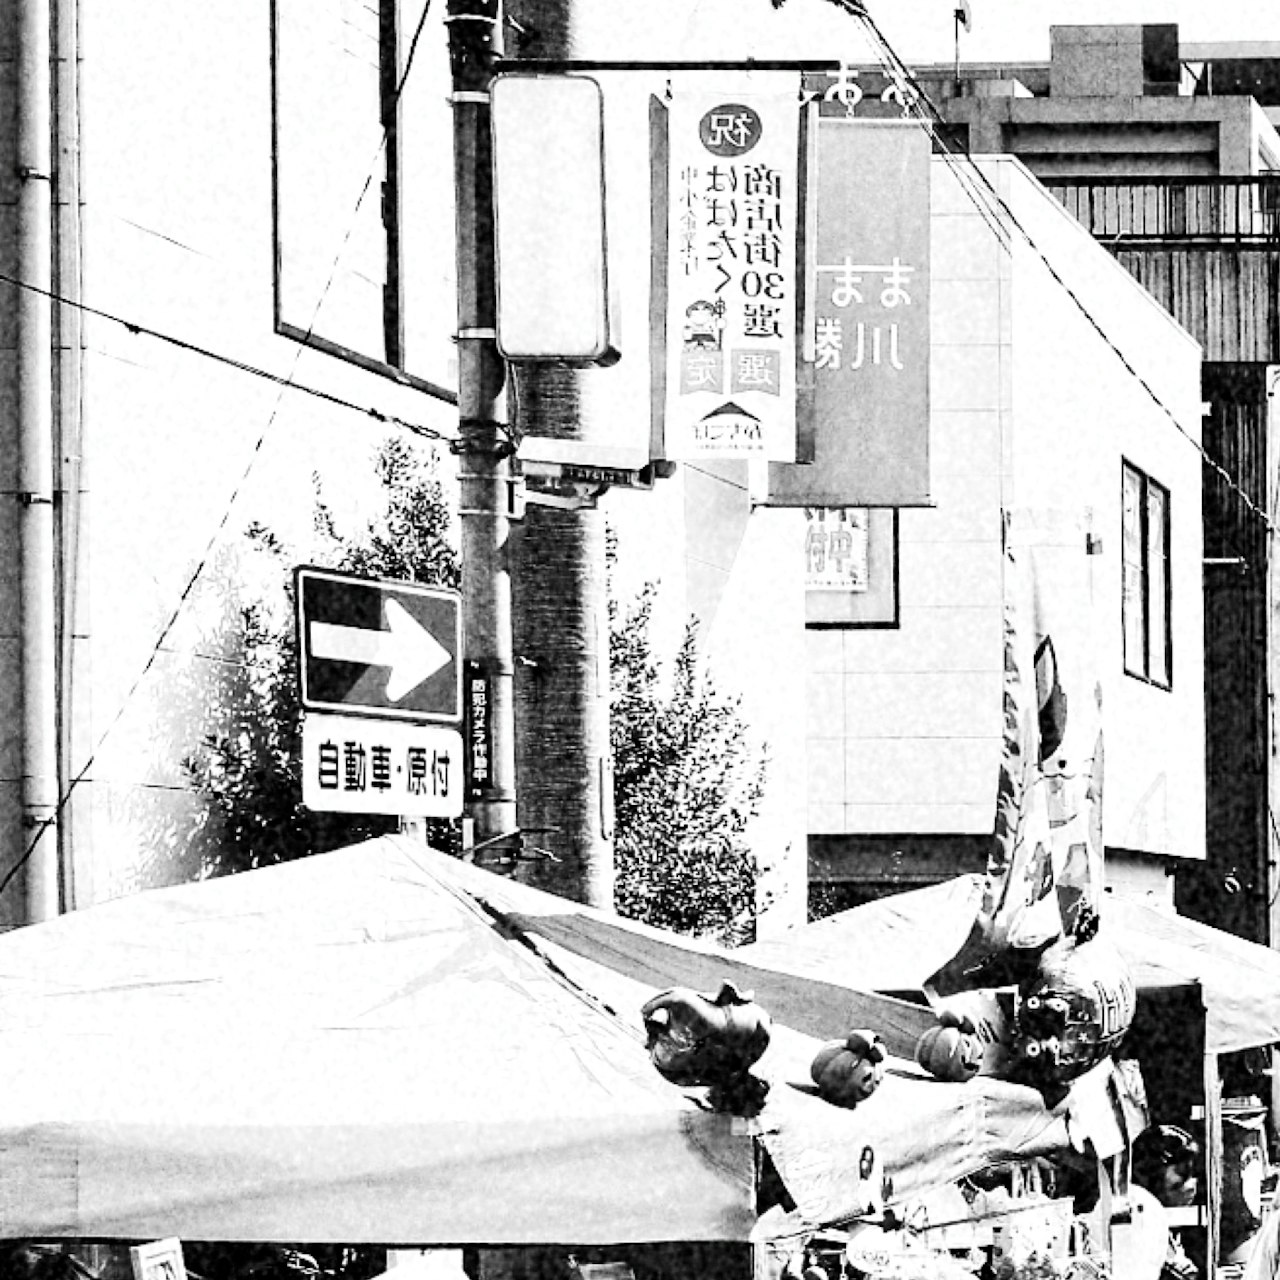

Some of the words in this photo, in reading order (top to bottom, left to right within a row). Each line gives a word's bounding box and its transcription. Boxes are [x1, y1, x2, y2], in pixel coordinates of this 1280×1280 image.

[318, 739, 451, 797] 自動車・原付
